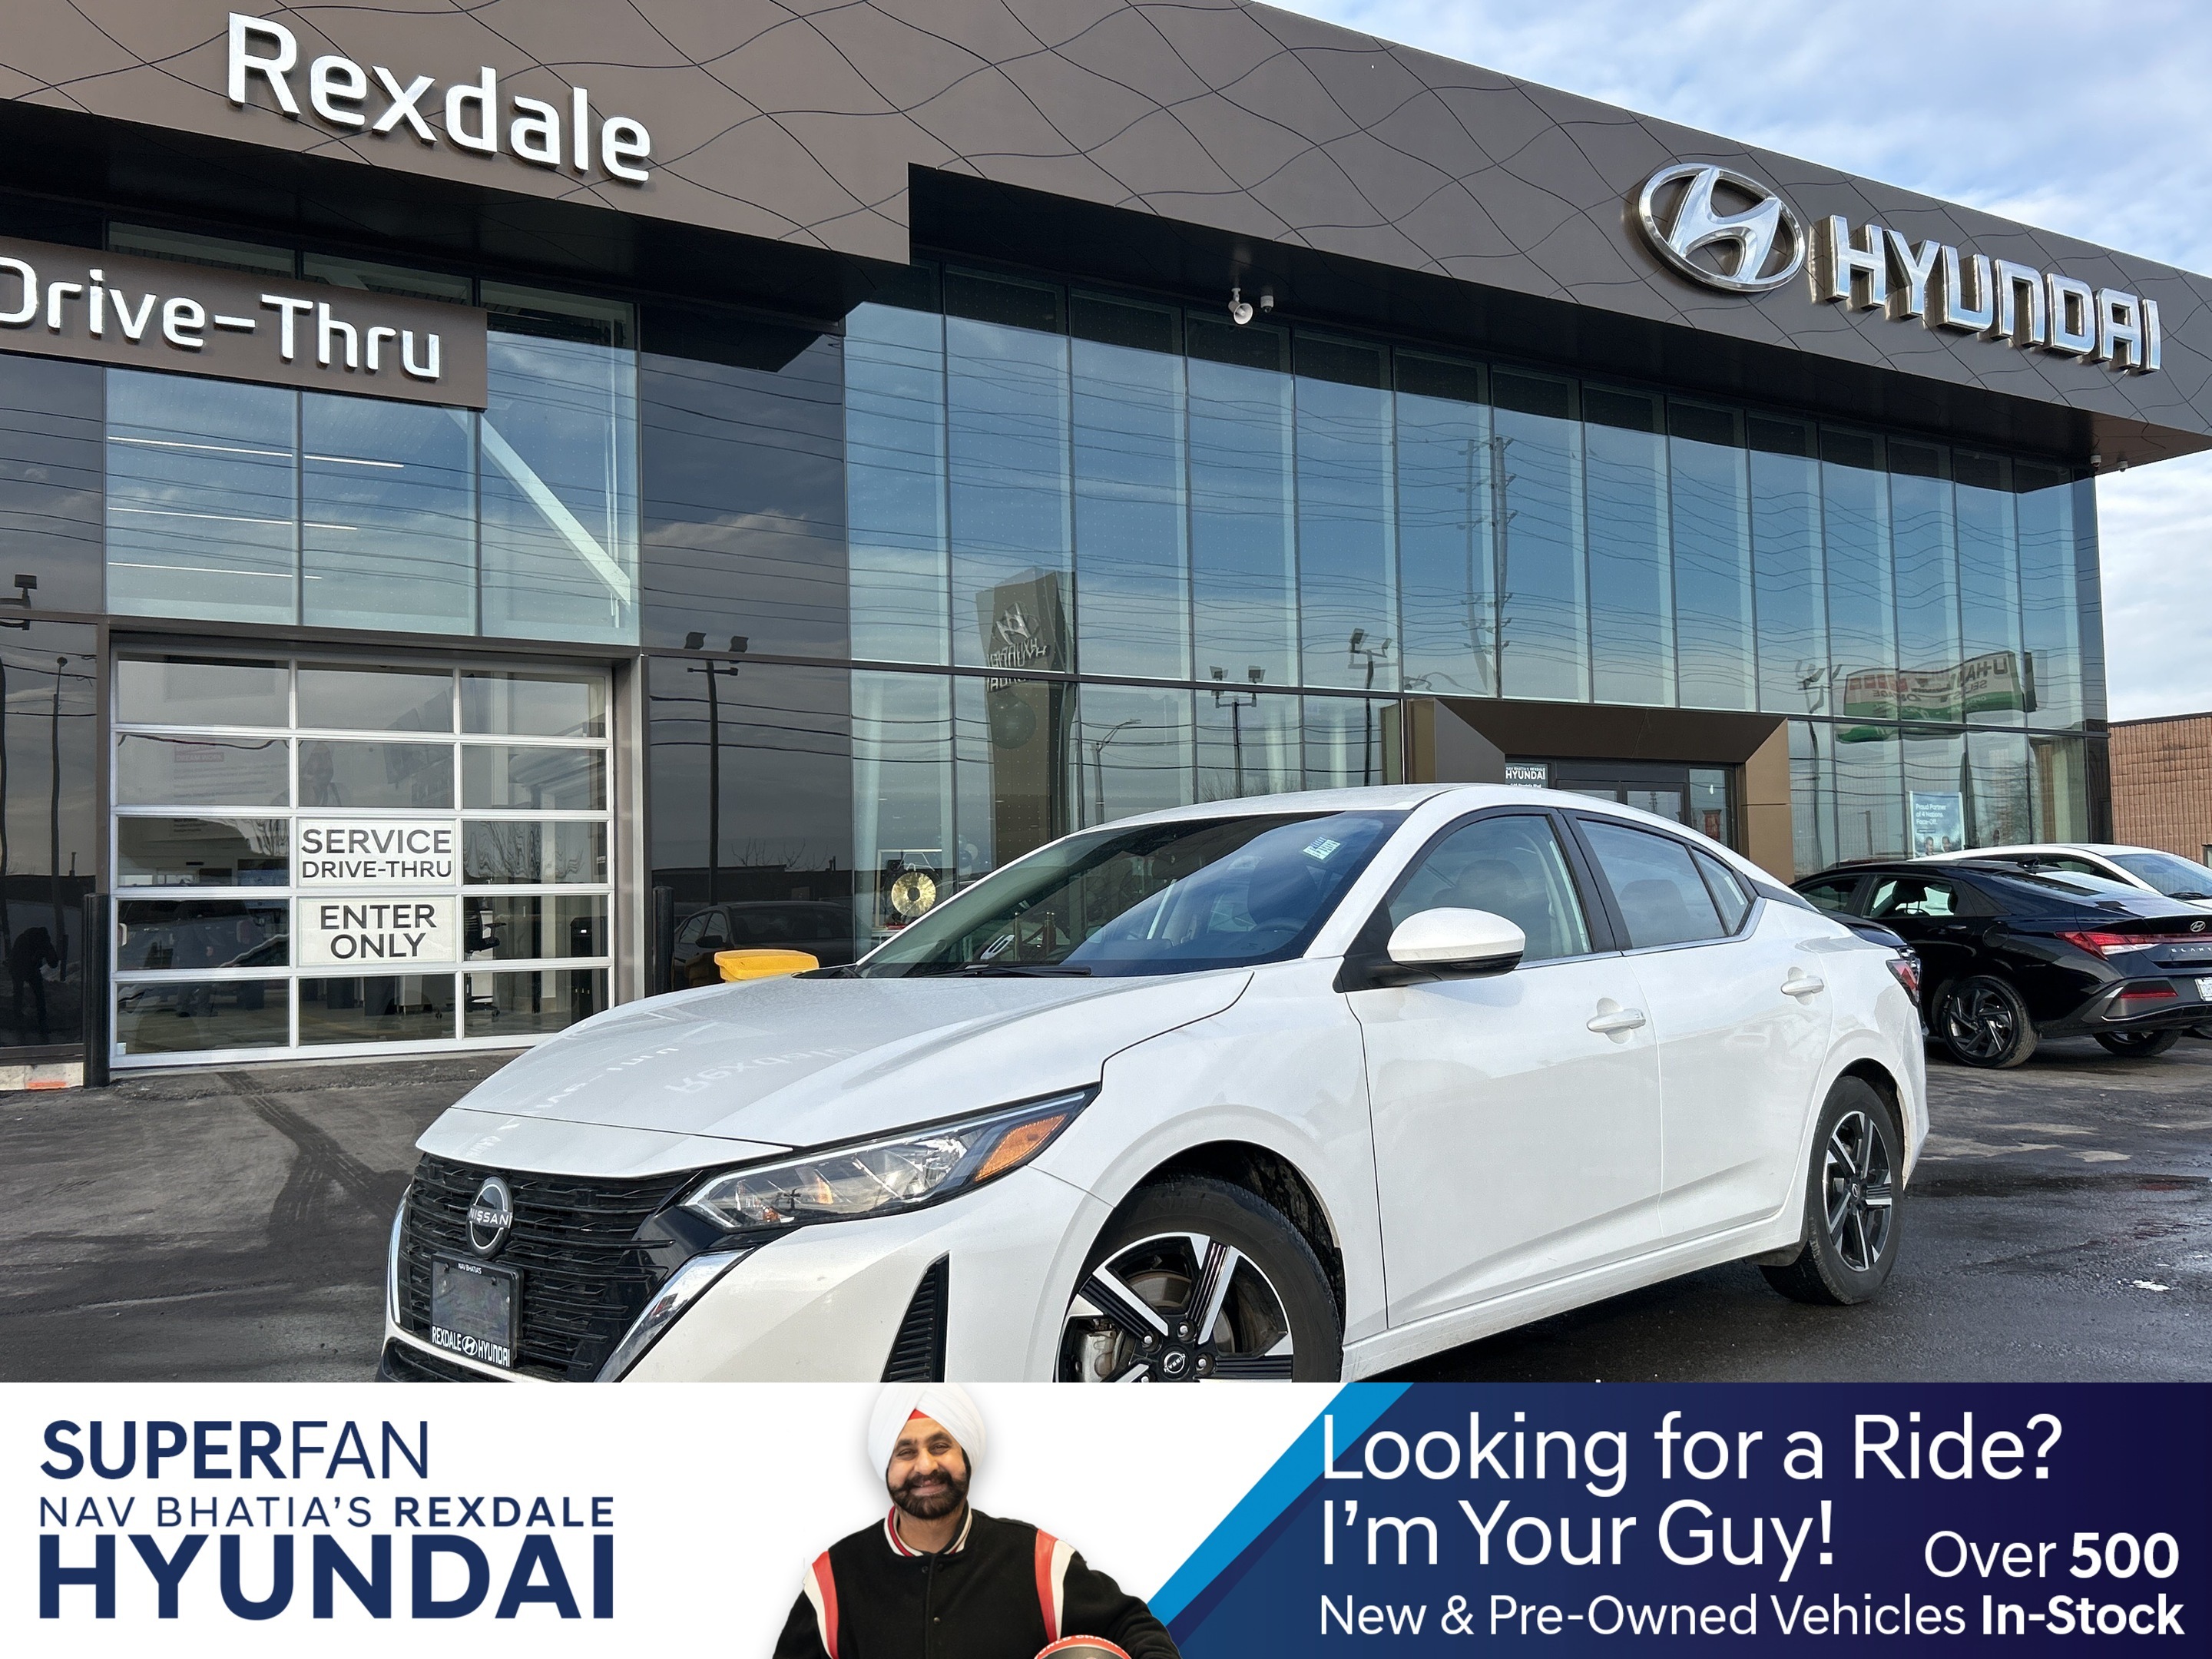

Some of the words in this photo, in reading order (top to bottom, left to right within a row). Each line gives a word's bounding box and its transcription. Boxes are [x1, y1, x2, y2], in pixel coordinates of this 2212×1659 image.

[227, 12, 652, 183] Rexdale
[1825, 214, 2163, 373] HYUNDAI
[0, 257, 442, 379] Drive-Thru
[1505, 770, 1545, 780] HYUNDAI
[301, 829, 452, 854] SERVICE
[303, 860, 452, 879] DRIVE-THRU
[320, 904, 437, 930] ENTER
[330, 932, 426, 959] ONLY
[468, 1207, 513, 1229] NISSAN
[432, 1326, 462, 1351] REXDALE
[478, 1339, 511, 1368] HYUNDAI
